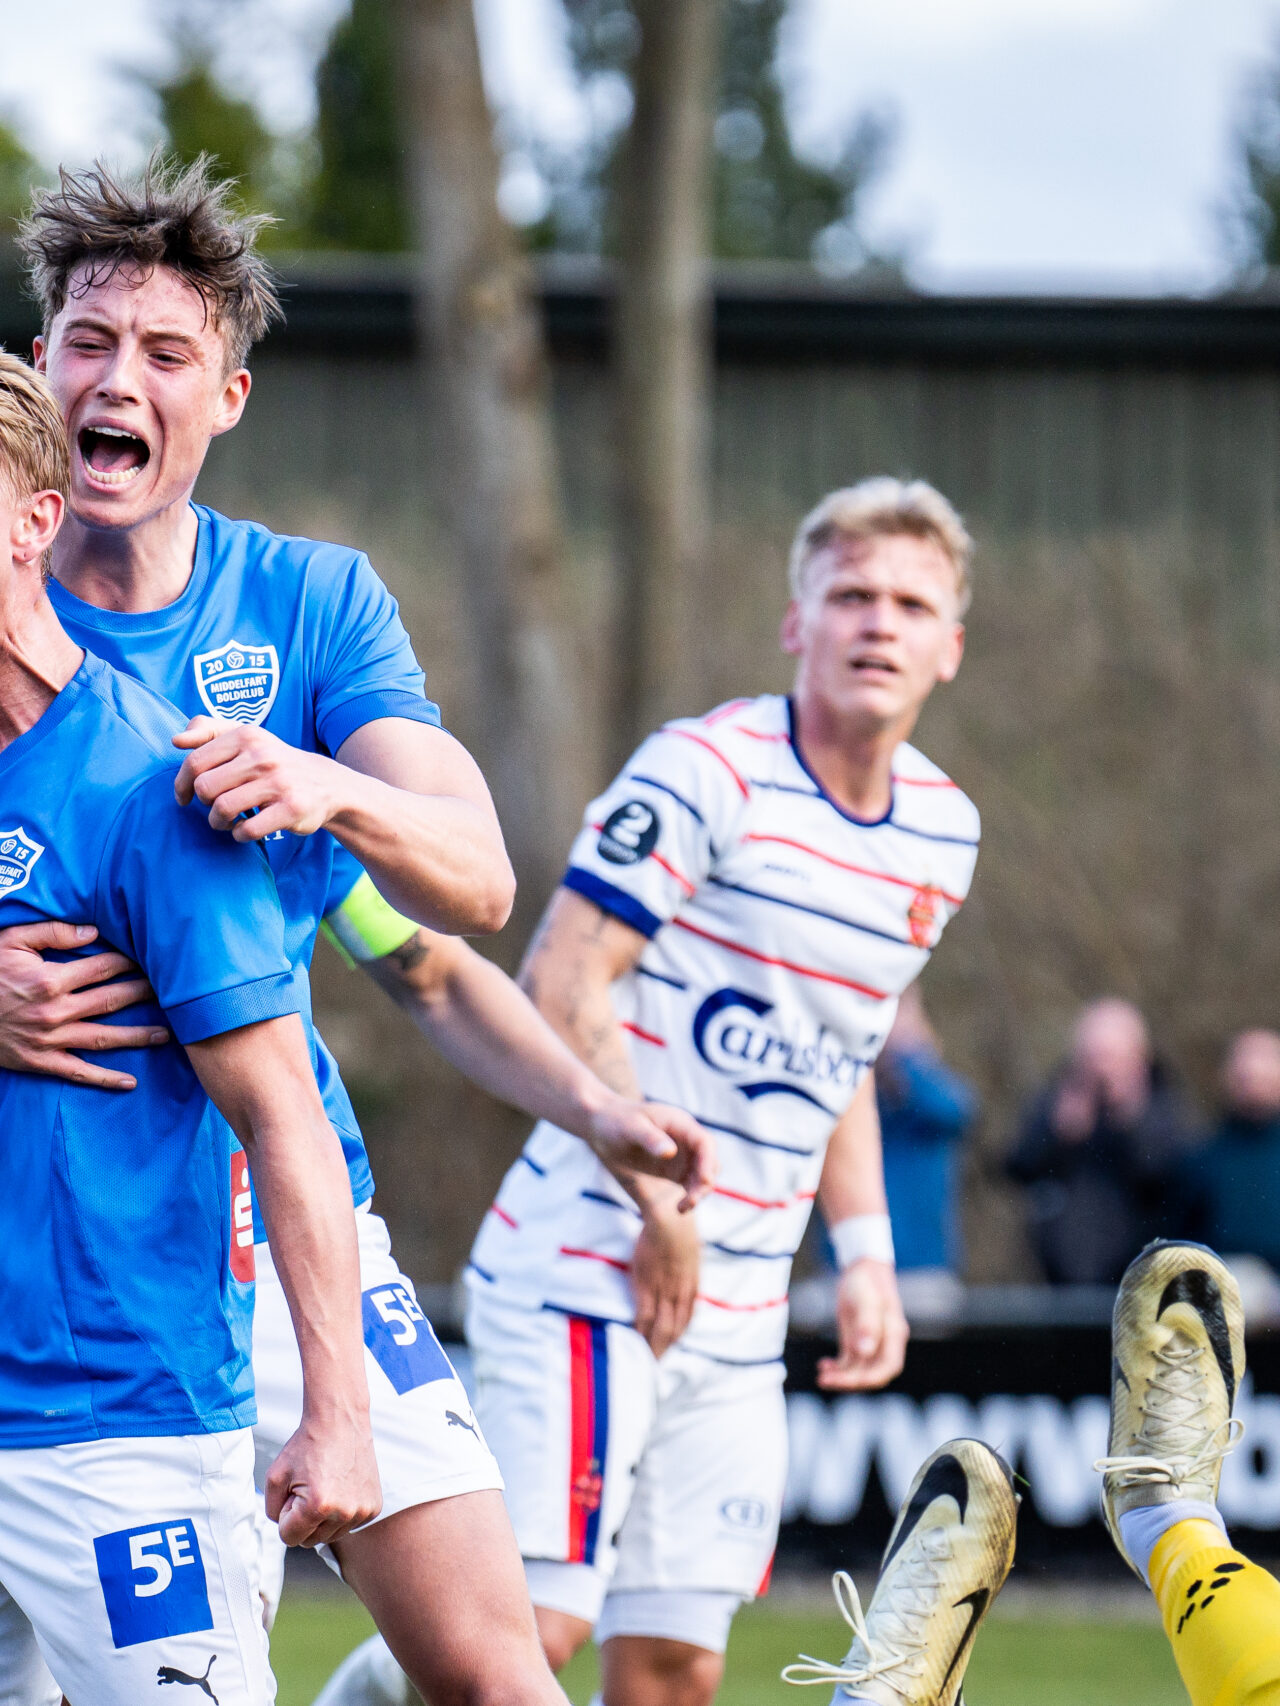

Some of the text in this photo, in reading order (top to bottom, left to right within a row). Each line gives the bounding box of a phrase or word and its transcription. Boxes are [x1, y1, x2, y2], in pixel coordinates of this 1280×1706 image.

[205, 655, 265, 675] 20 15
[210, 675, 268, 693] MIDDELFART
[216, 687, 265, 703] BOLDKLUB
[14, 846, 30, 860] 15
